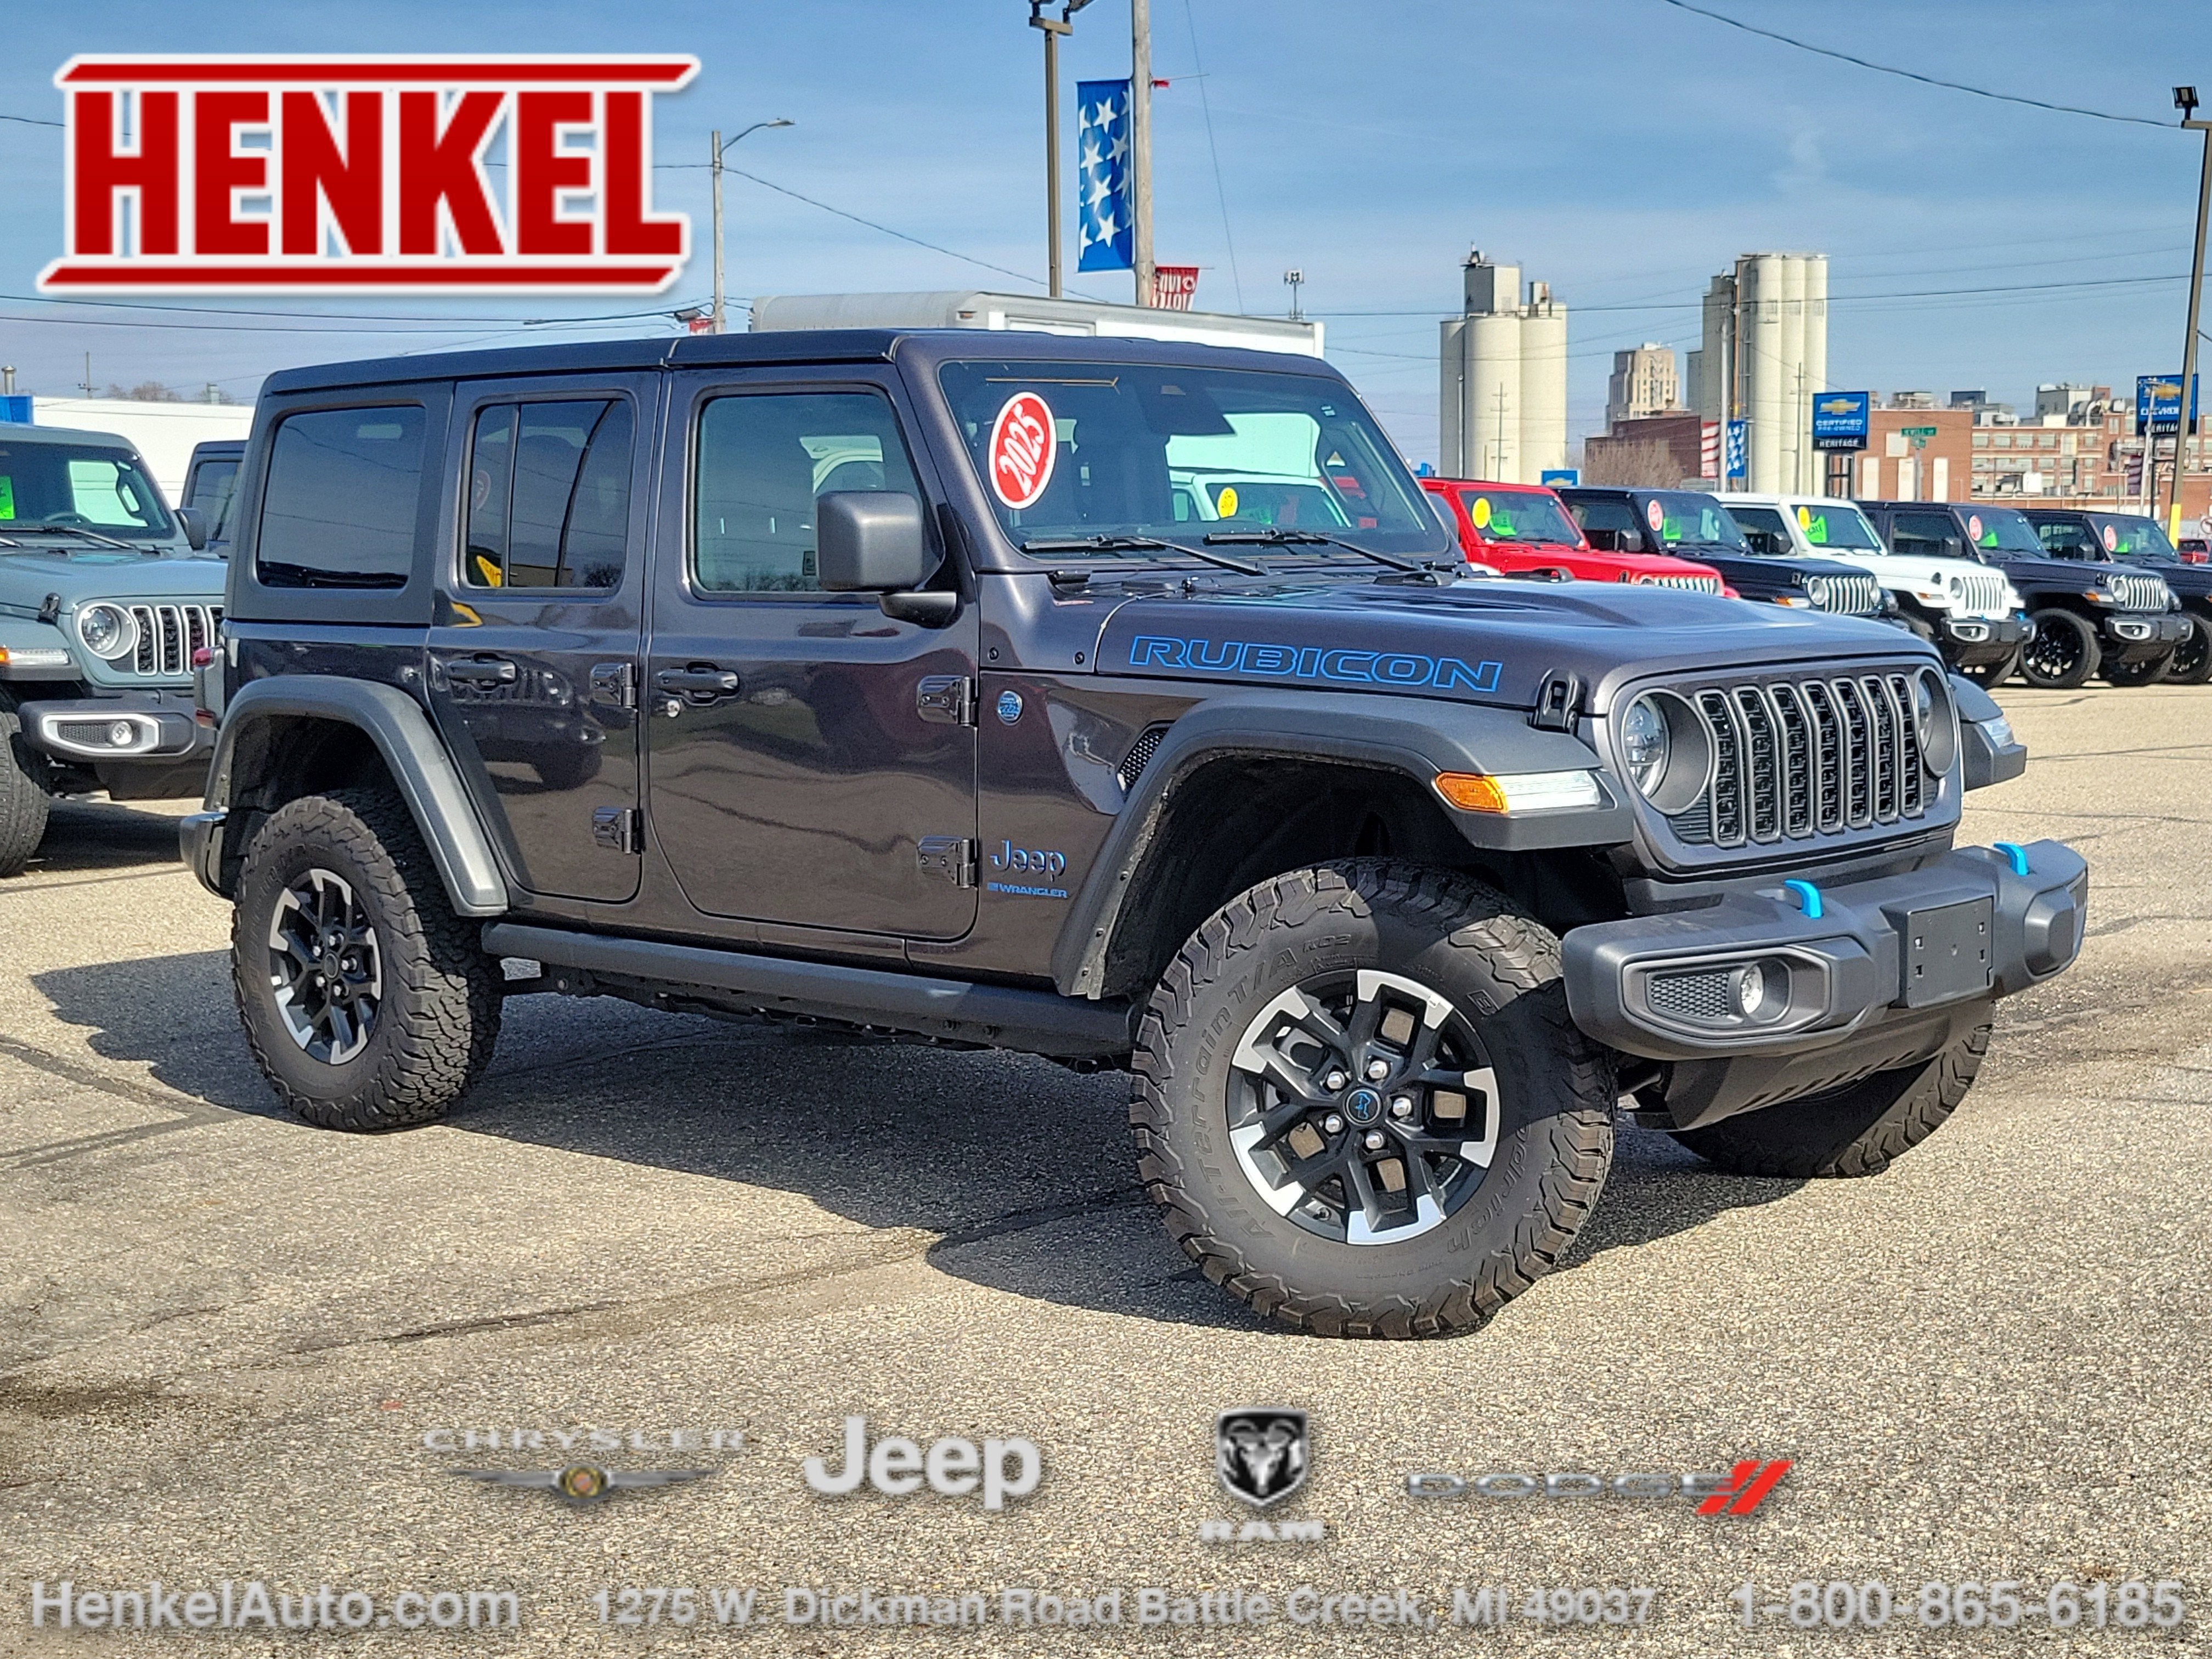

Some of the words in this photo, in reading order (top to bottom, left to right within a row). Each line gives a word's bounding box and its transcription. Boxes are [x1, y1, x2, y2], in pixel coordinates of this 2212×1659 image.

[998, 402, 1046, 497] 2025
[1819, 438, 1859, 448] HERITAGE
[1129, 636, 1504, 693] RUBICON
[989, 839, 1066, 883] Jeep
[998, 883, 1068, 899] WRANGLER
[1191, 1006, 1276, 1239] All-Terrain
